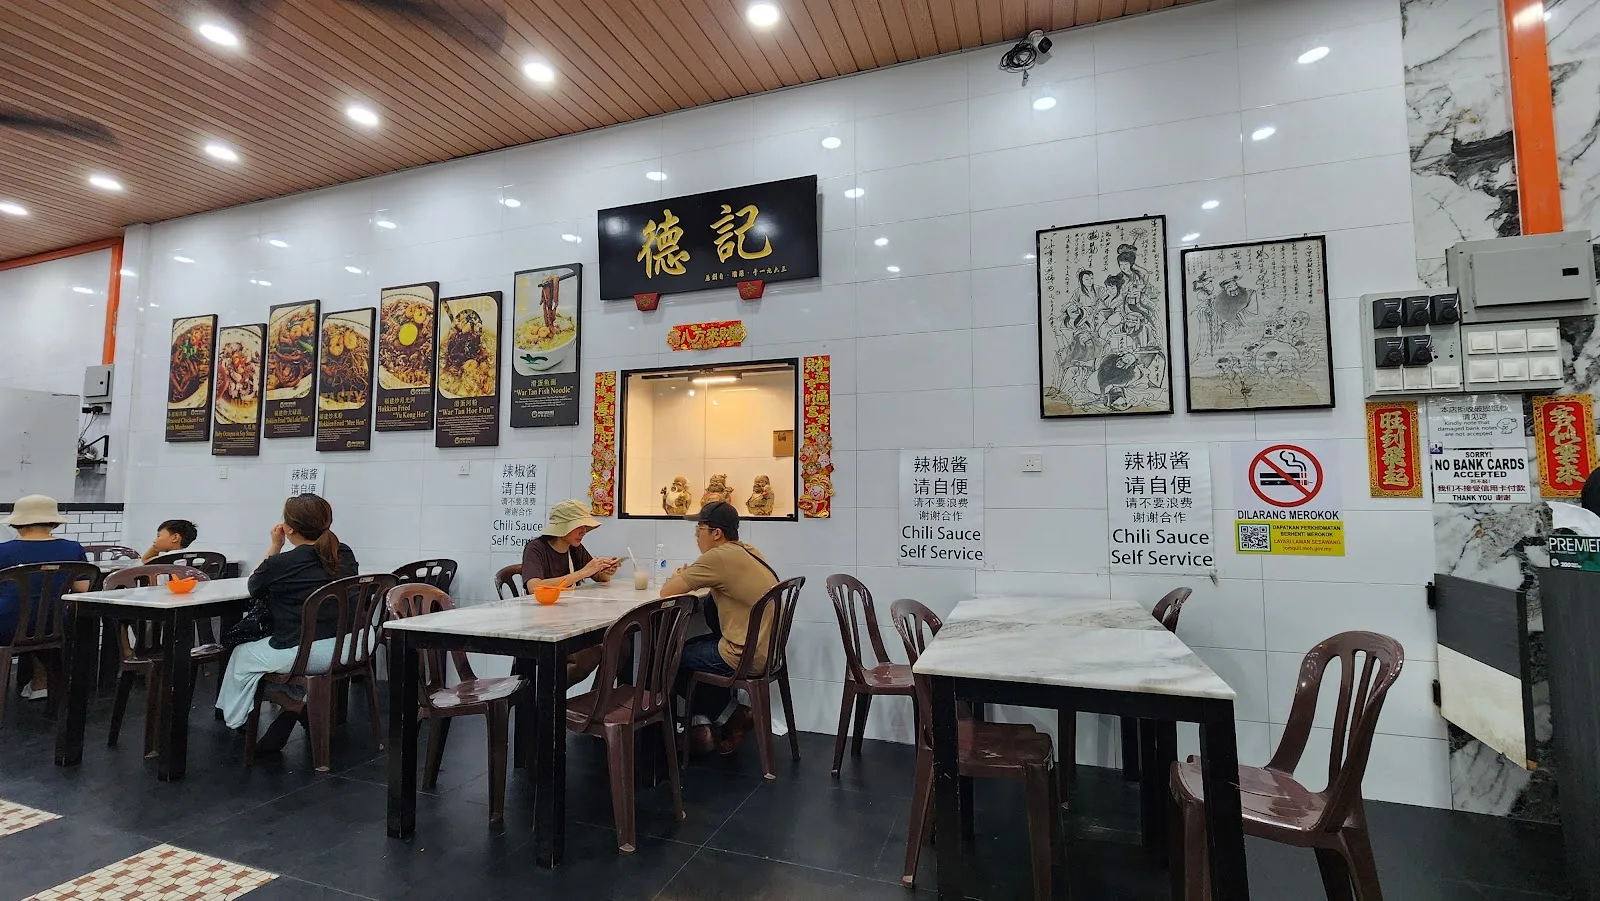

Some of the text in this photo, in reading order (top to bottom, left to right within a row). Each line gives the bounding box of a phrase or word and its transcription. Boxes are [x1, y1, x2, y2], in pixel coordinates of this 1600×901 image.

[637, 204, 773, 279] 德記
[538, 387, 549, 395] Fish
[914, 455, 968, 473] 辣椒酱
[1124, 451, 1190, 470] 辣椒酱
[1435, 458, 1525, 471] NO BANK CARDS
[502, 463, 537, 478] 辣椒酱
[501, 481, 537, 496] 请自便
[913, 477, 968, 495] 请自便
[1124, 475, 1192, 495] 请自便
[1437, 484, 1526, 492] 我们不接受信用卡付款
[913, 497, 969, 508] 请不要浪费
[1125, 497, 1193, 509] 请不要浪费
[919, 510, 963, 521] 谢谢合作
[1133, 511, 1187, 523] 谢谢合作
[1237, 510, 1340, 520] DILARANG MEROKOK
[493, 519, 543, 531] Chili Sauce
[491, 534, 508, 546] Self
[902, 525, 981, 541] Chili Sauce
[1112, 528, 1209, 544] Chili Sauce
[900, 544, 983, 560] Self Service
[1111, 549, 1213, 566] Self Service
